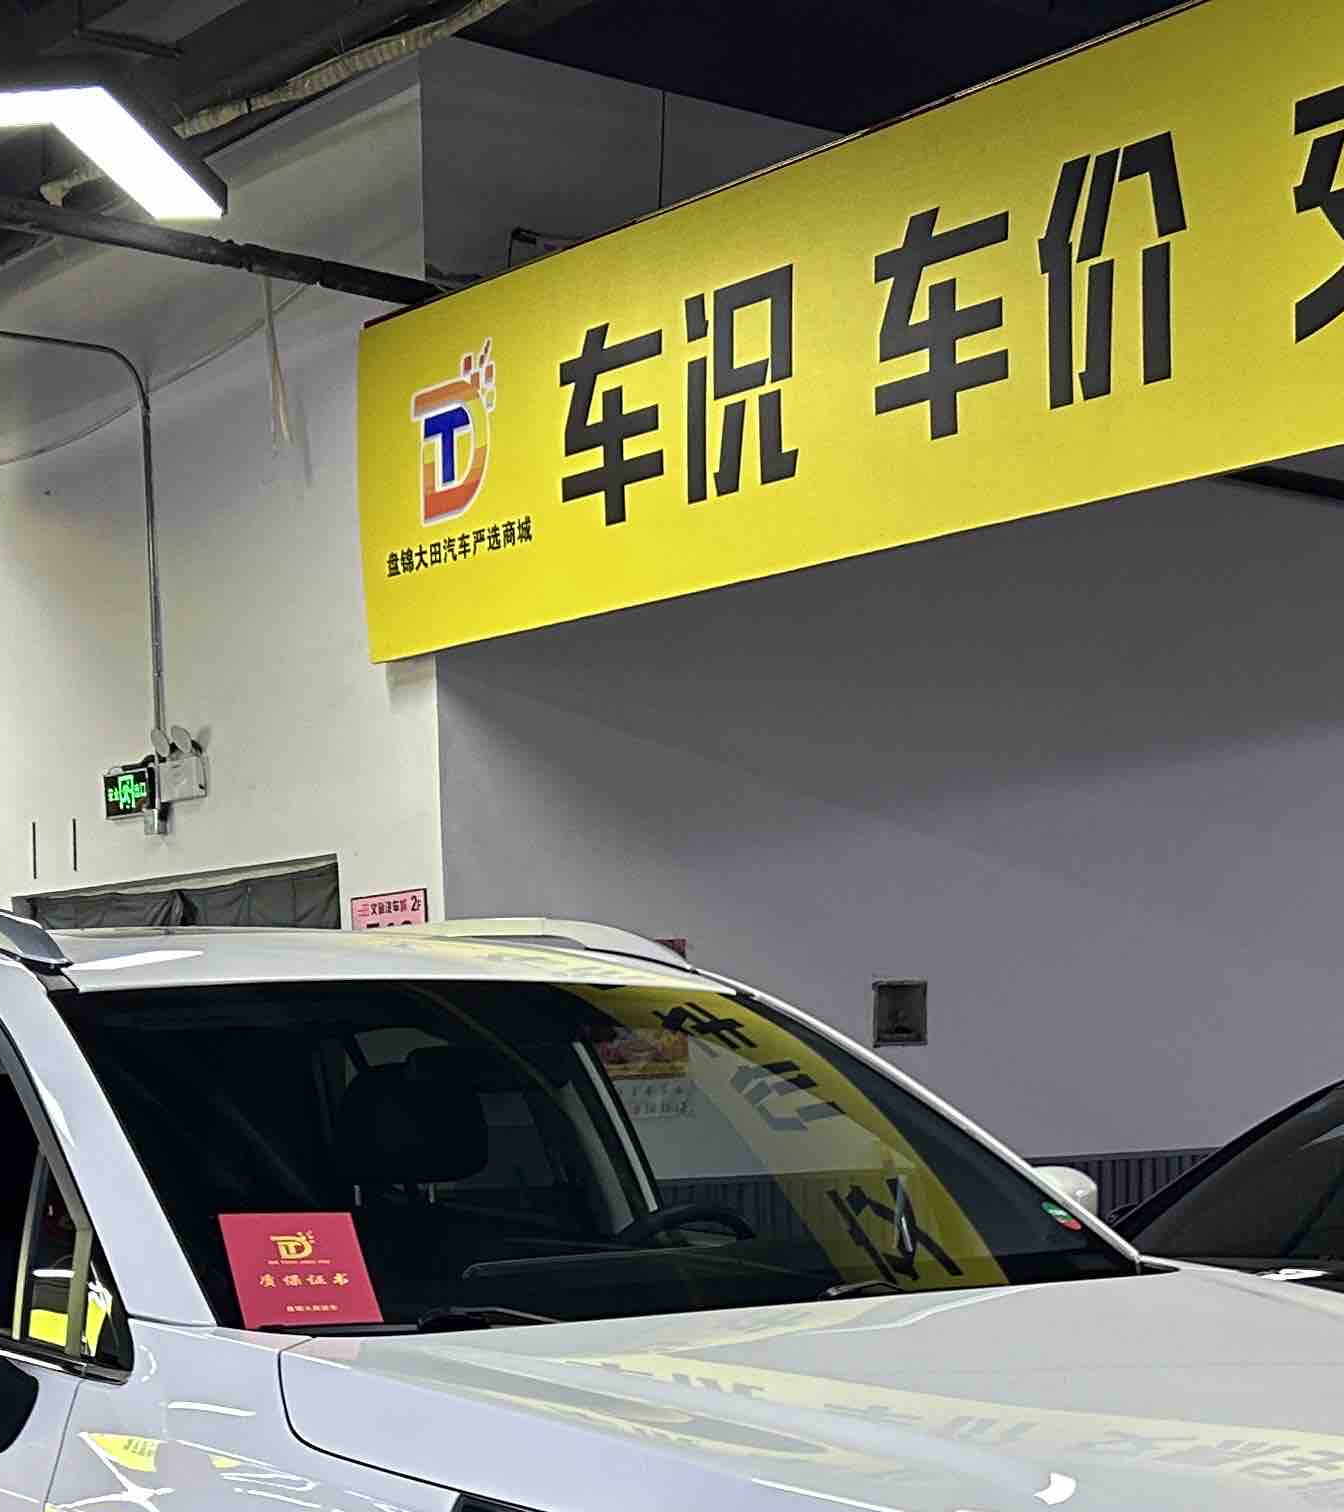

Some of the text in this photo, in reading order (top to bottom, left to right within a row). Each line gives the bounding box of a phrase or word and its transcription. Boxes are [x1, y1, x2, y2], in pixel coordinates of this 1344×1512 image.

[559, 264, 798, 525] 车况
[874, 131, 1187, 441] 车价
[386, 516, 533, 578] 盘锦大田汽车严选商城
